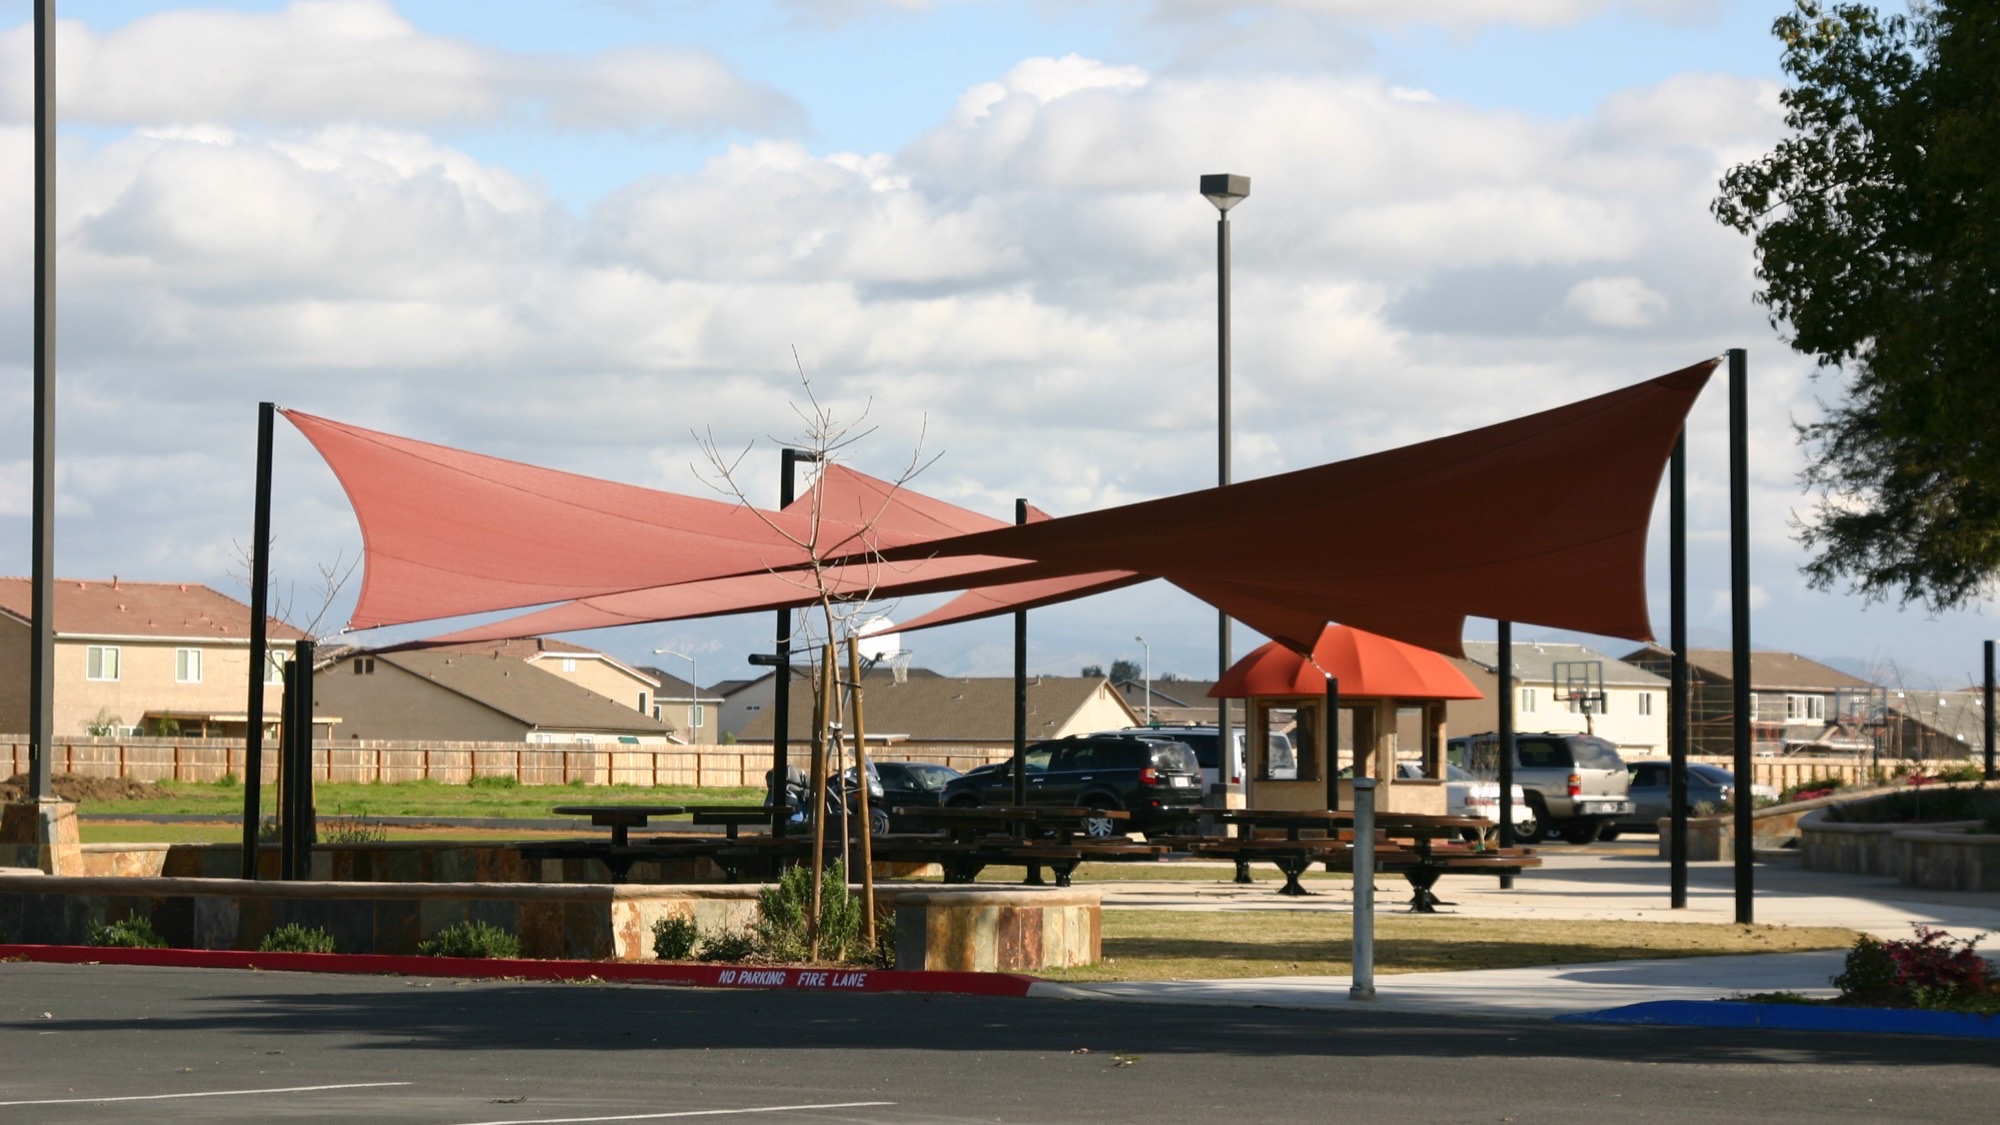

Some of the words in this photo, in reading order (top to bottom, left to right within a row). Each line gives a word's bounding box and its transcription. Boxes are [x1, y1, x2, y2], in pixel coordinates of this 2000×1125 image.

[718, 970, 736, 984] NO
[737, 970, 786, 985] PARKING
[797, 972, 828, 986] FIRE
[832, 973, 867, 987] LANE
